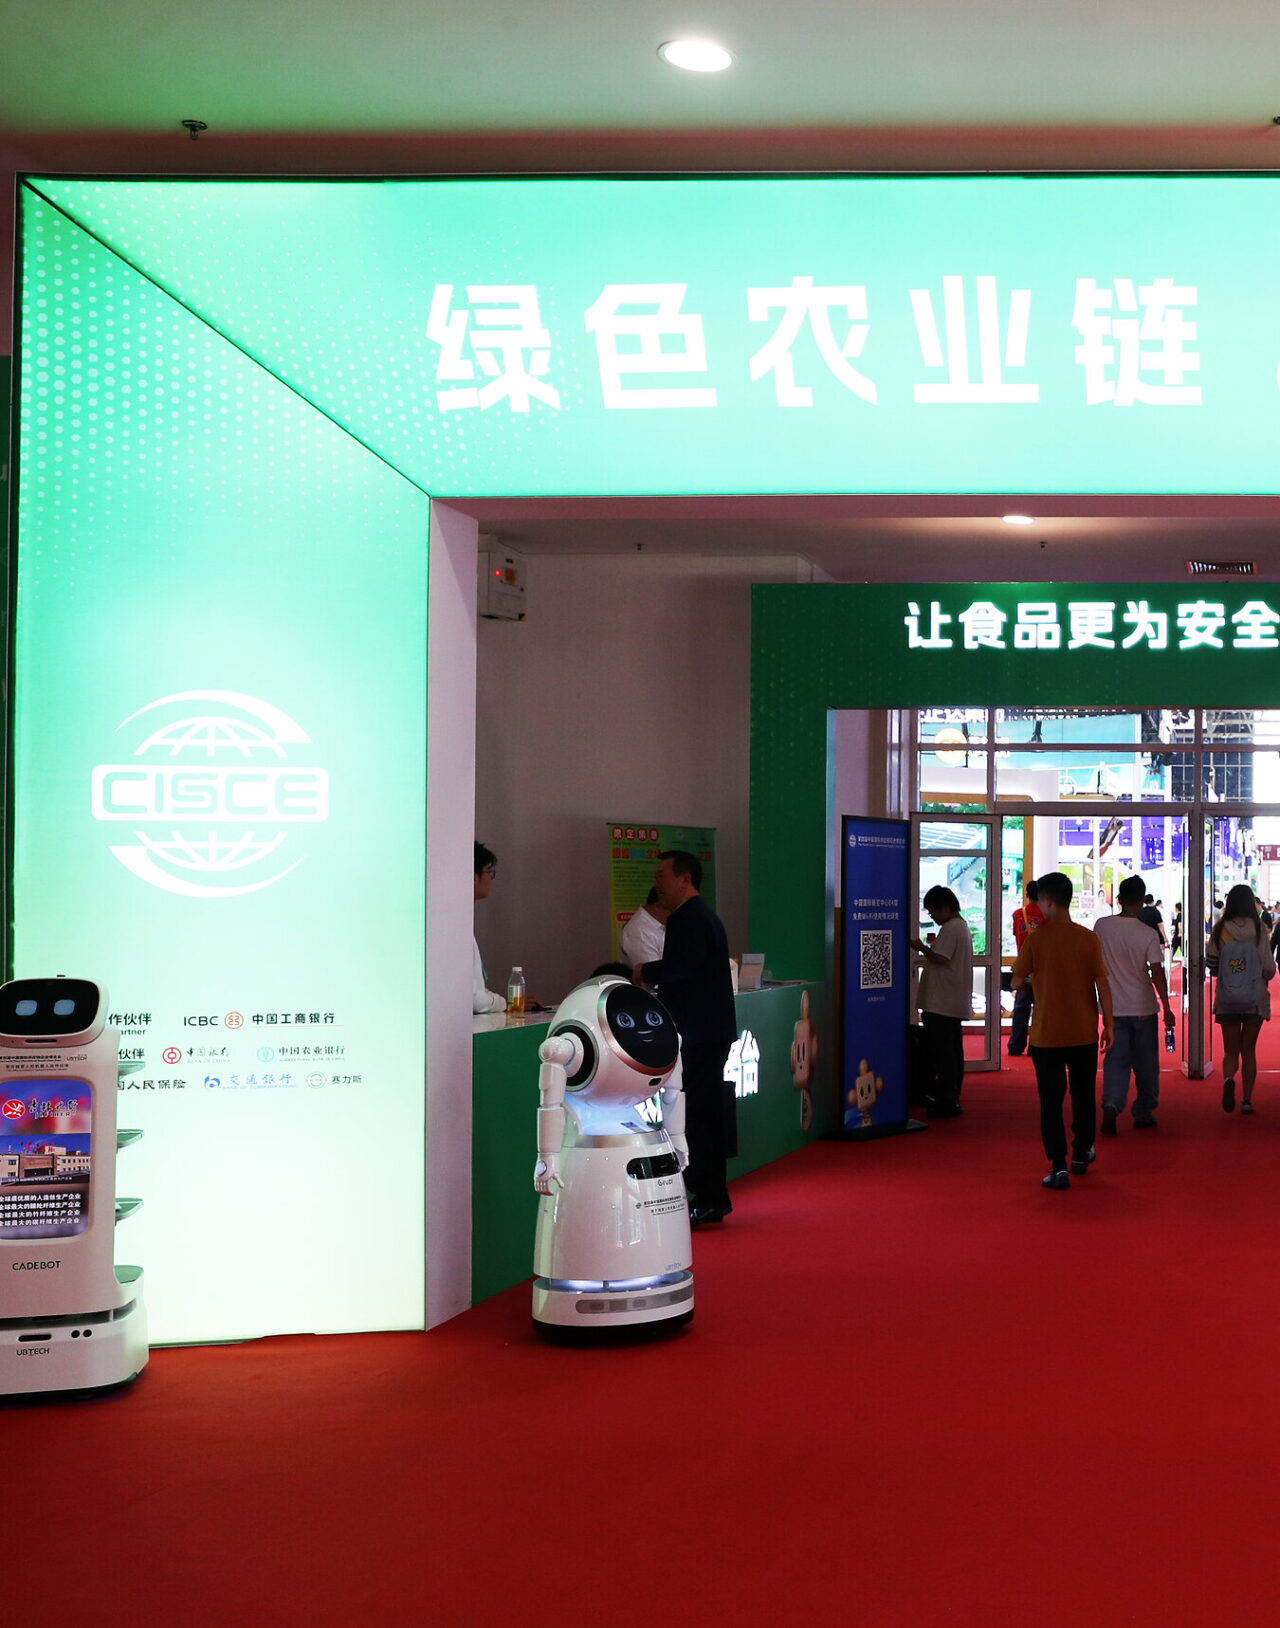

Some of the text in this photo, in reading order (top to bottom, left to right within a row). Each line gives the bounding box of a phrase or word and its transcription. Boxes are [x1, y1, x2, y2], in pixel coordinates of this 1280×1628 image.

[425, 275, 1203, 412] 绿色农业链
[904, 600, 1280, 650] 让食品更为安全
[102, 771, 319, 816] CISCE
[183, 1016, 219, 1026] ICBC
[252, 1013, 335, 1025] 中国工商银行
[278, 1045, 346, 1056] 中国农业银行
[331, 1075, 362, 1085] 赛力斯
[12, 1260, 61, 1271] CADEBOT
[16, 1347, 50, 1357] UBTECH
